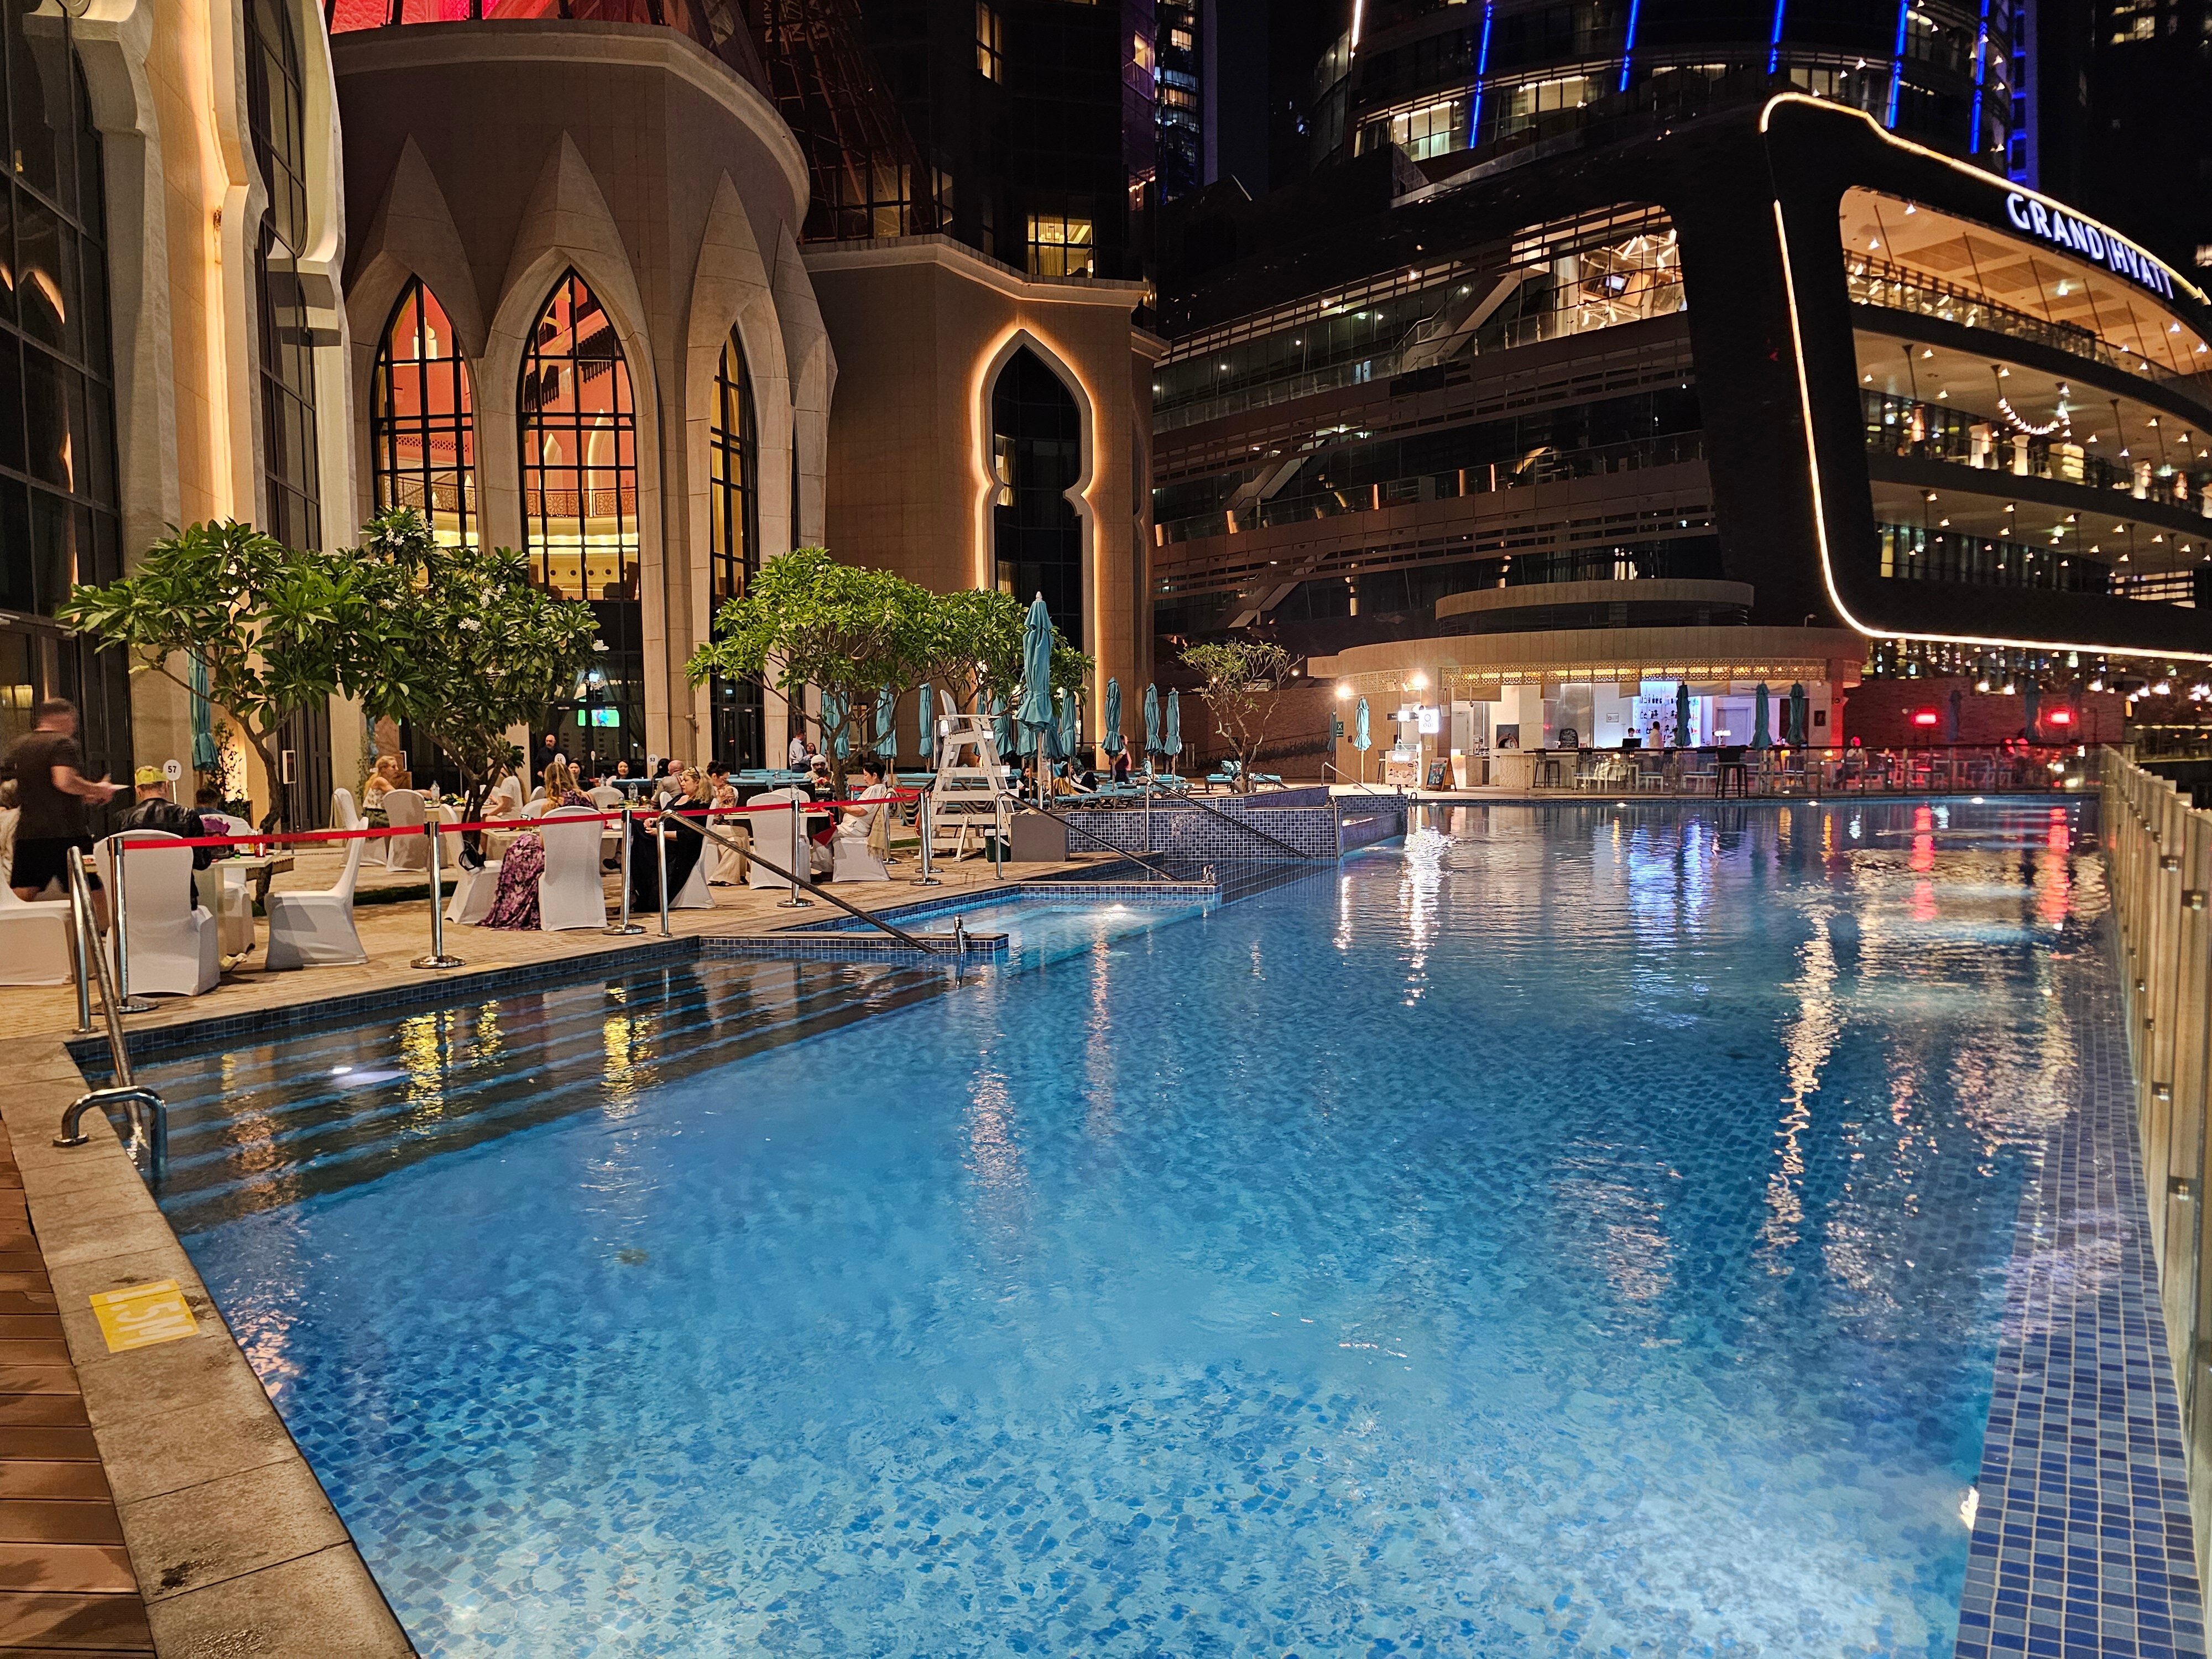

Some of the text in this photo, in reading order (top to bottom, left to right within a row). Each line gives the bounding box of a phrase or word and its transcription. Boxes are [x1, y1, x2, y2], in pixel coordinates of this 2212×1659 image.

[2006, 192, 2174, 300] GRAND HYATT
[107, 1284, 193, 1345] 1.5M
